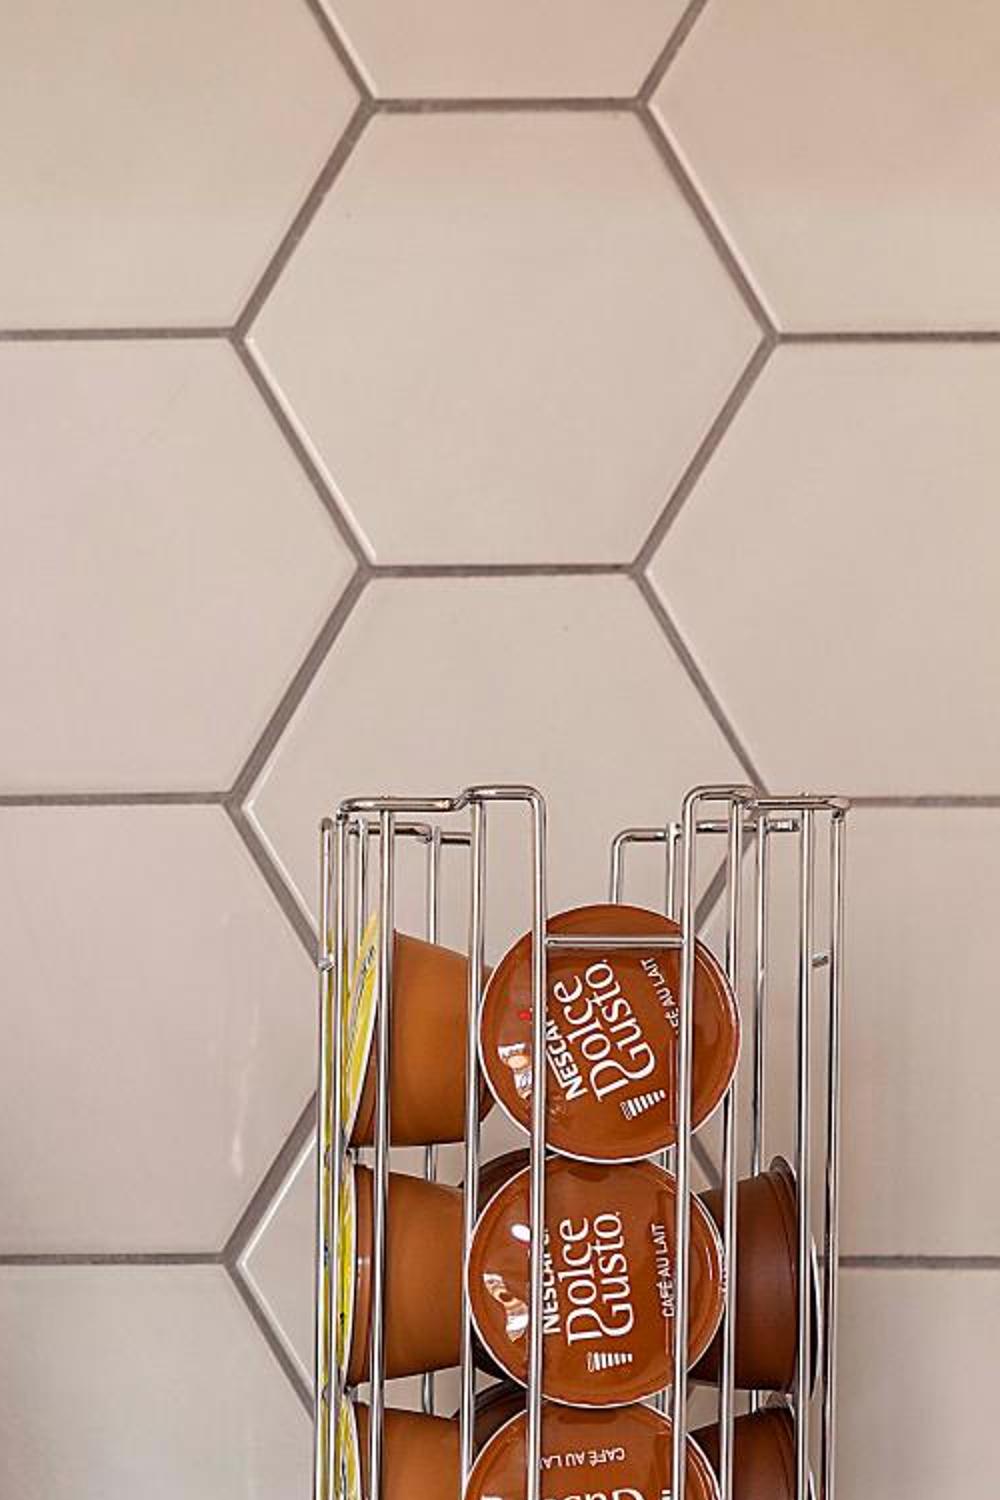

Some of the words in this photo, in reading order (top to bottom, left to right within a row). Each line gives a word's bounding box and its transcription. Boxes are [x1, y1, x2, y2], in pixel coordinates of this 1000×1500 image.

[641, 957, 664, 987] LAIT
[586, 963, 655, 1080] Gusto
[554, 976, 628, 1101] Dolce
[651, 1223, 668, 1254] LAIT
[558, 1218, 602, 1346] Dolce
[591, 1213, 634, 1338] Gusto
[656, 1258, 671, 1277] AU
[566, 1452, 585, 1467] AU
[589, 1447, 625, 1467] CAFÉ
